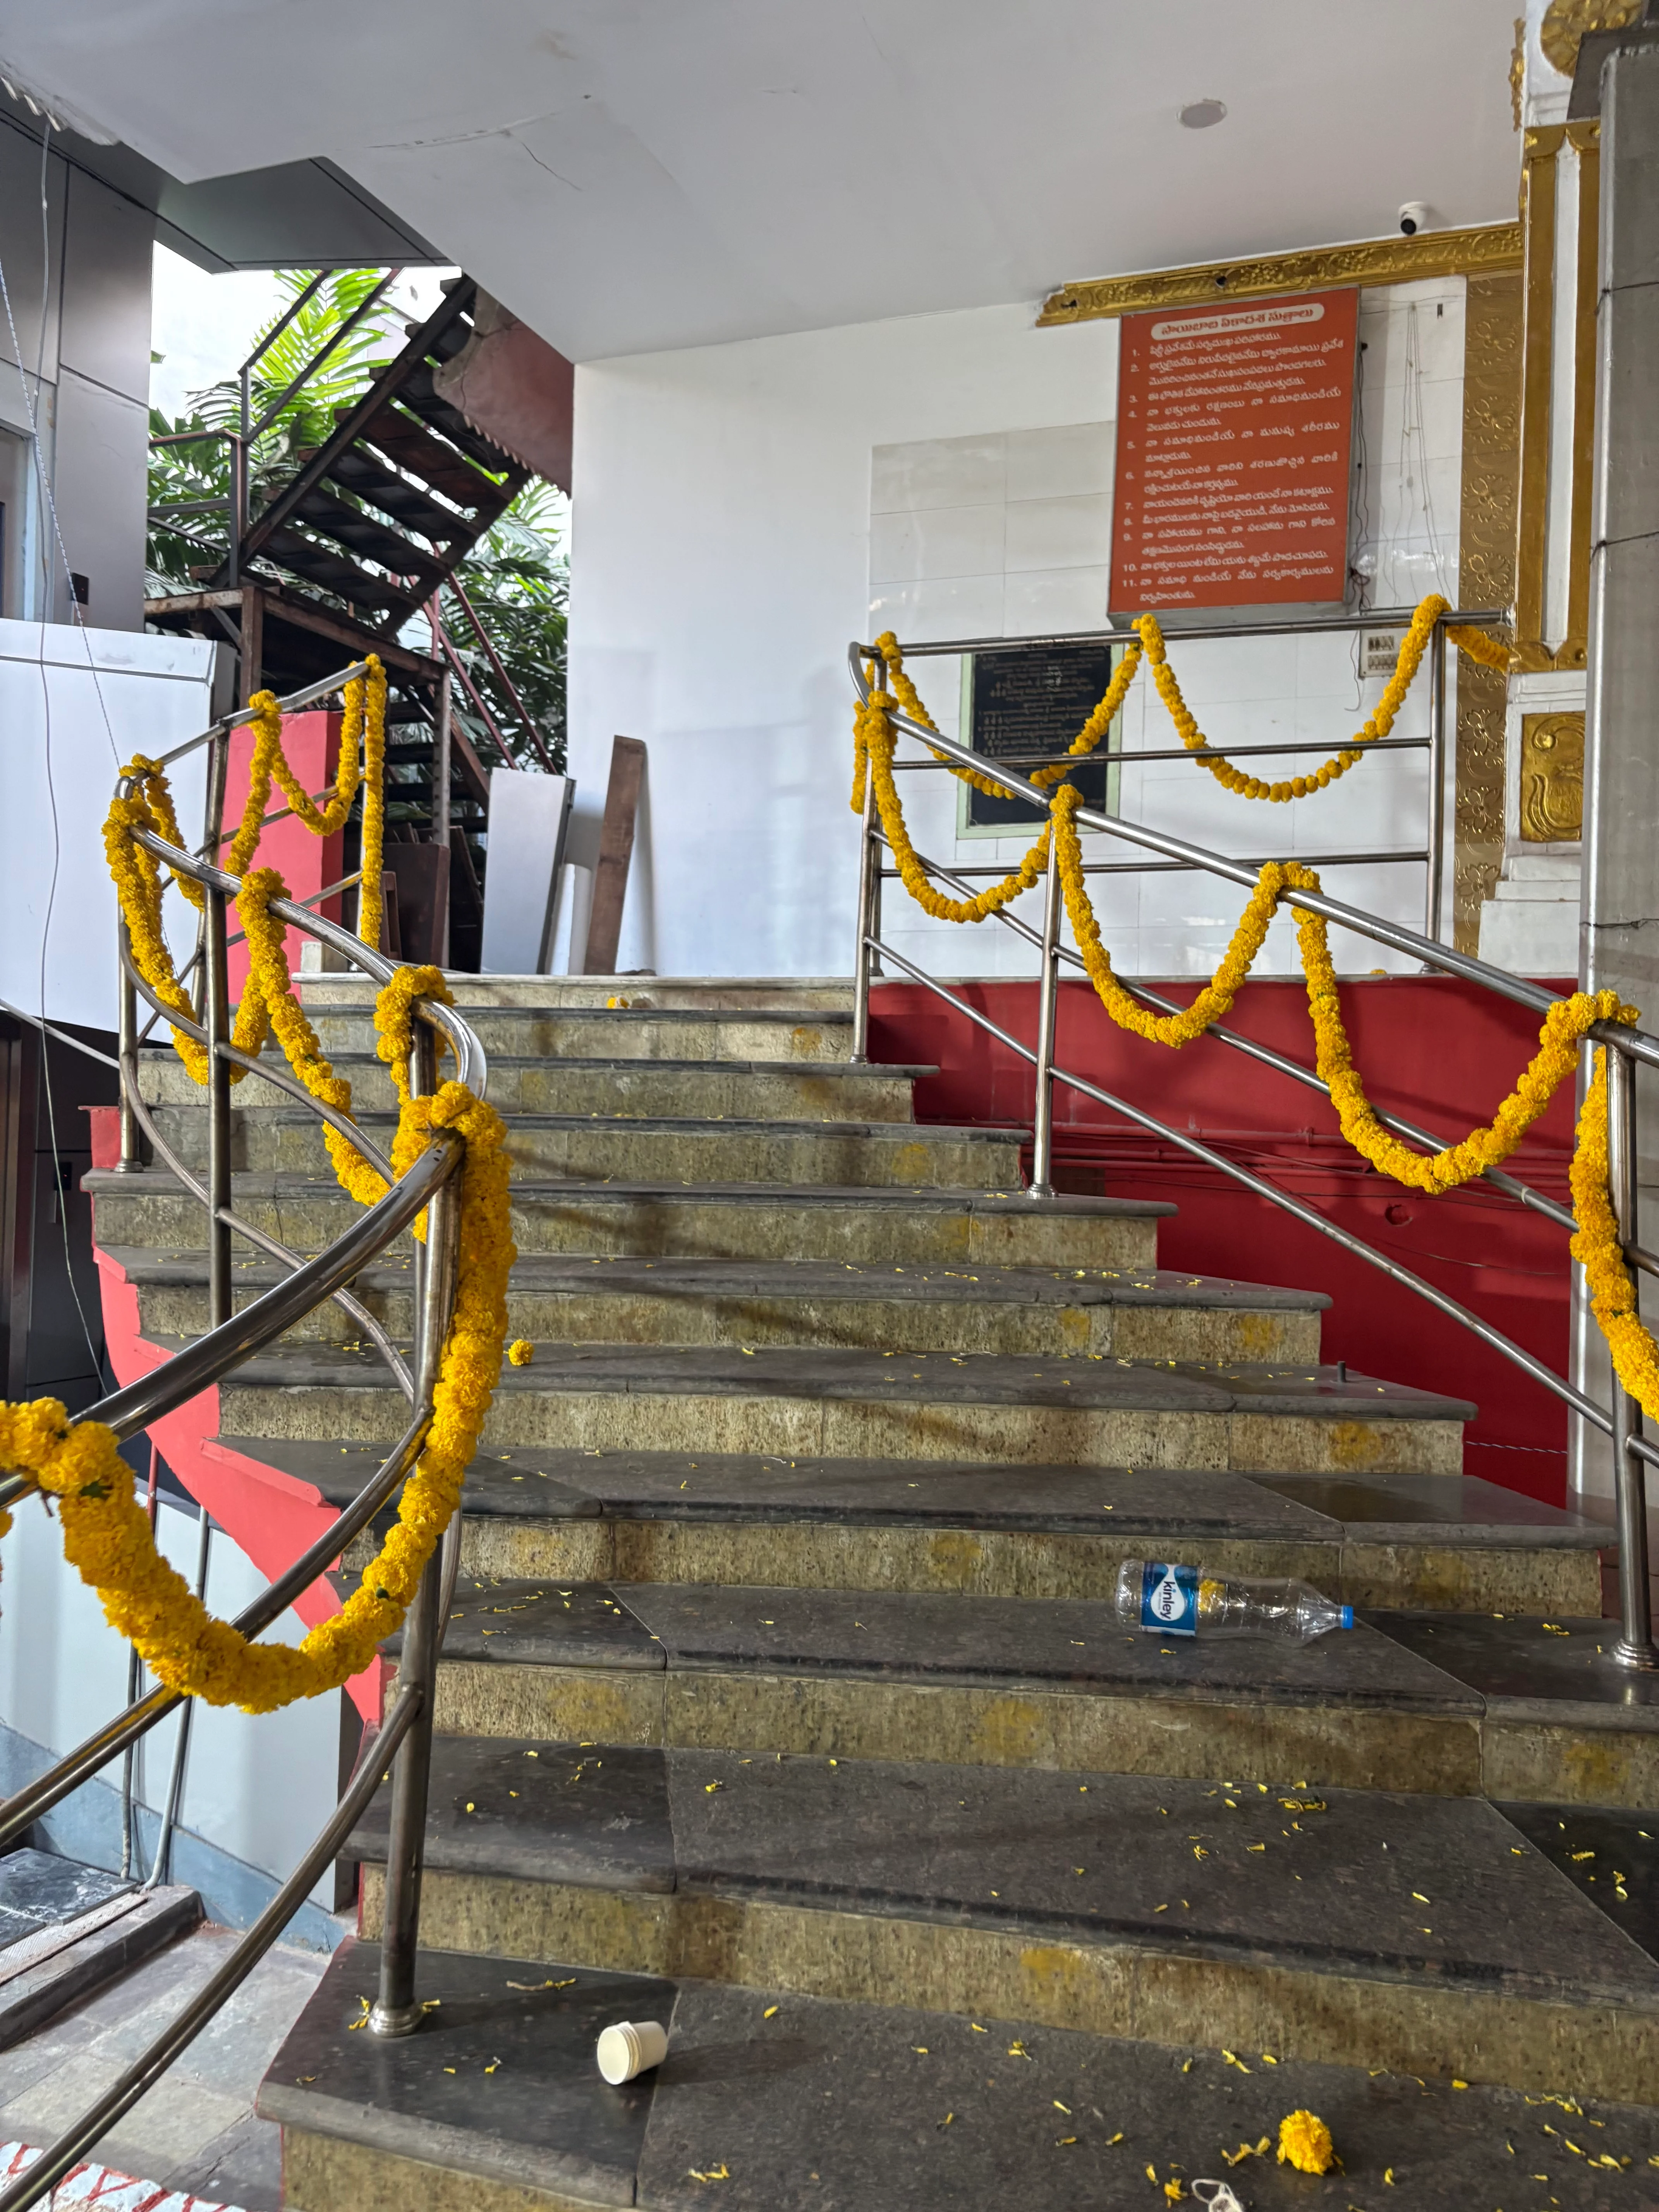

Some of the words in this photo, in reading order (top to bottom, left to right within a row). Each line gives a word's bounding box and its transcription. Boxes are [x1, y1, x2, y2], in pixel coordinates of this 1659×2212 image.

[1250, 398, 1263, 406] నా
[1241, 430, 1254, 438] నా
[1125, 502, 1133, 510] 7.
[1288, 520, 1307, 529] గాని
[1123, 563, 1137, 572] 10.
[1122, 579, 1137, 587] 11.
[1237, 569, 1257, 579] నేను
[1160, 1581, 1176, 1620] kinley
